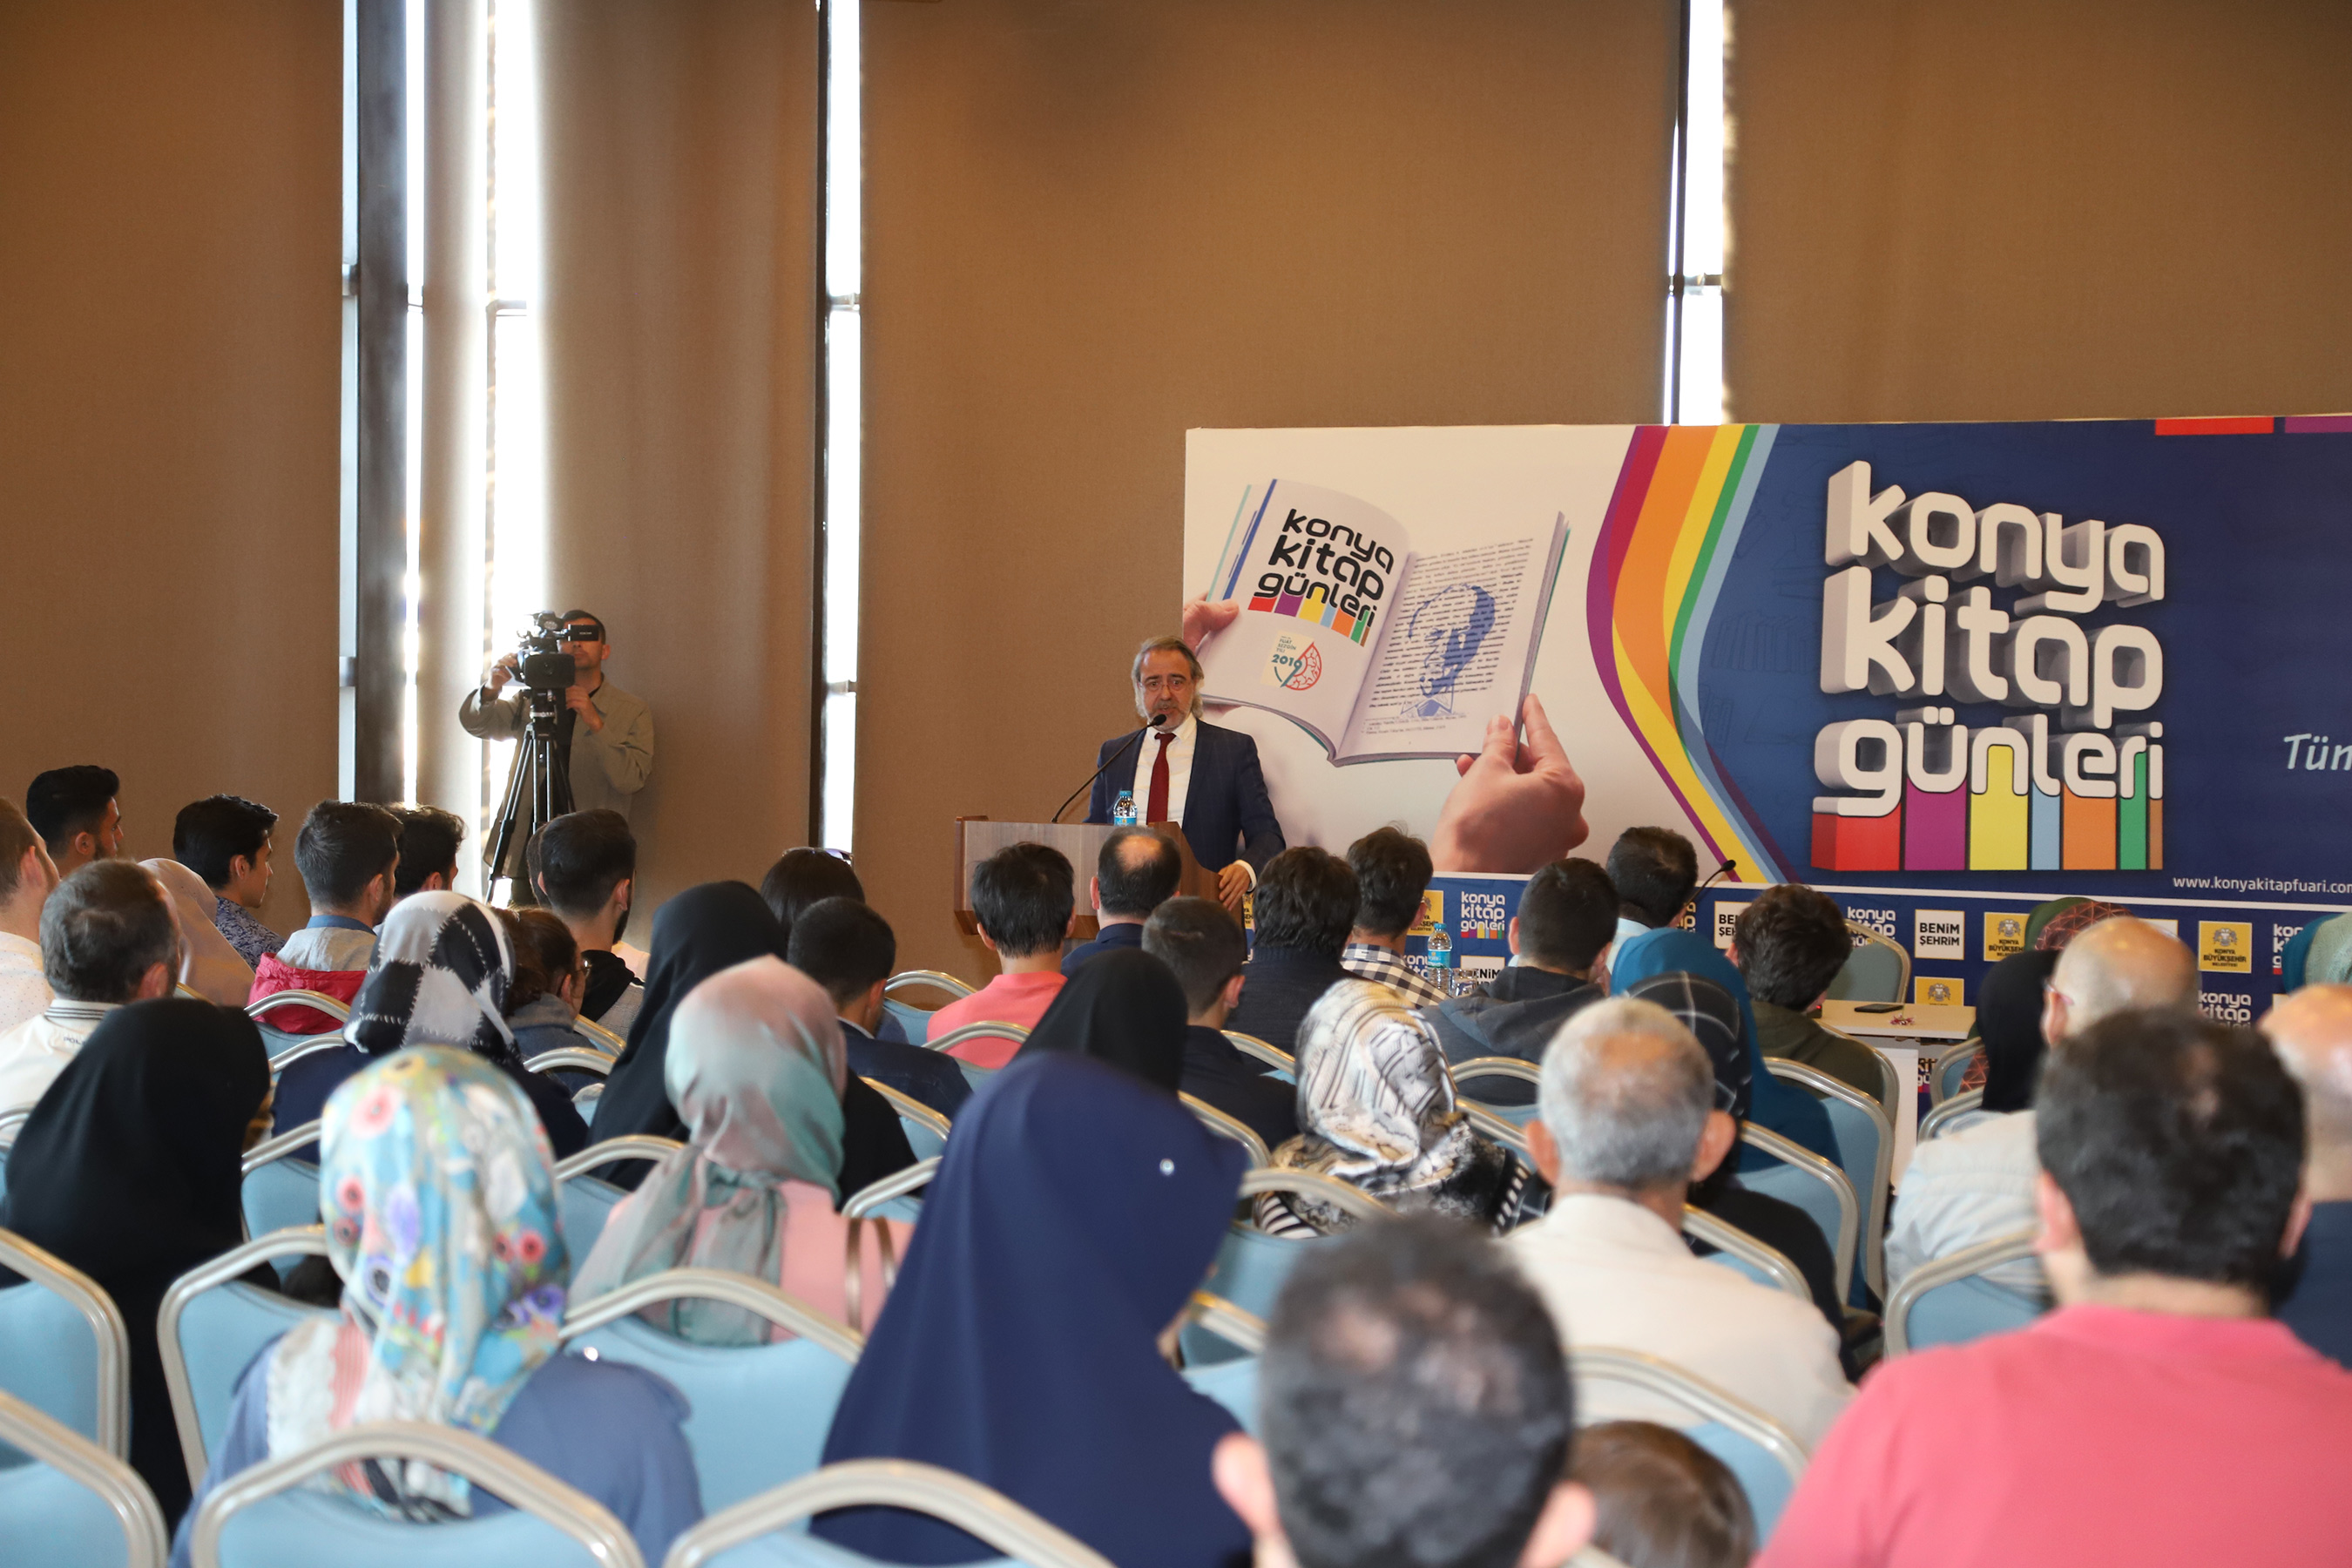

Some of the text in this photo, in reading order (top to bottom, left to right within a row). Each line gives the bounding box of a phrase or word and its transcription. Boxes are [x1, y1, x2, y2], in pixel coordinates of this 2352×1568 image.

[1281, 508, 1395, 575] konya
[1825, 459, 2166, 613] konya
[1267, 534, 1384, 601] kitap
[1253, 571, 1377, 628] günleri
[1820, 565, 2164, 730] kitap
[1812, 706, 2164, 818] günleri
[1461, 890, 1505, 908] konya
[1461, 903, 1505, 923] kitap
[1461, 919, 1505, 932] günleri
[1848, 906, 1896, 924] konya
